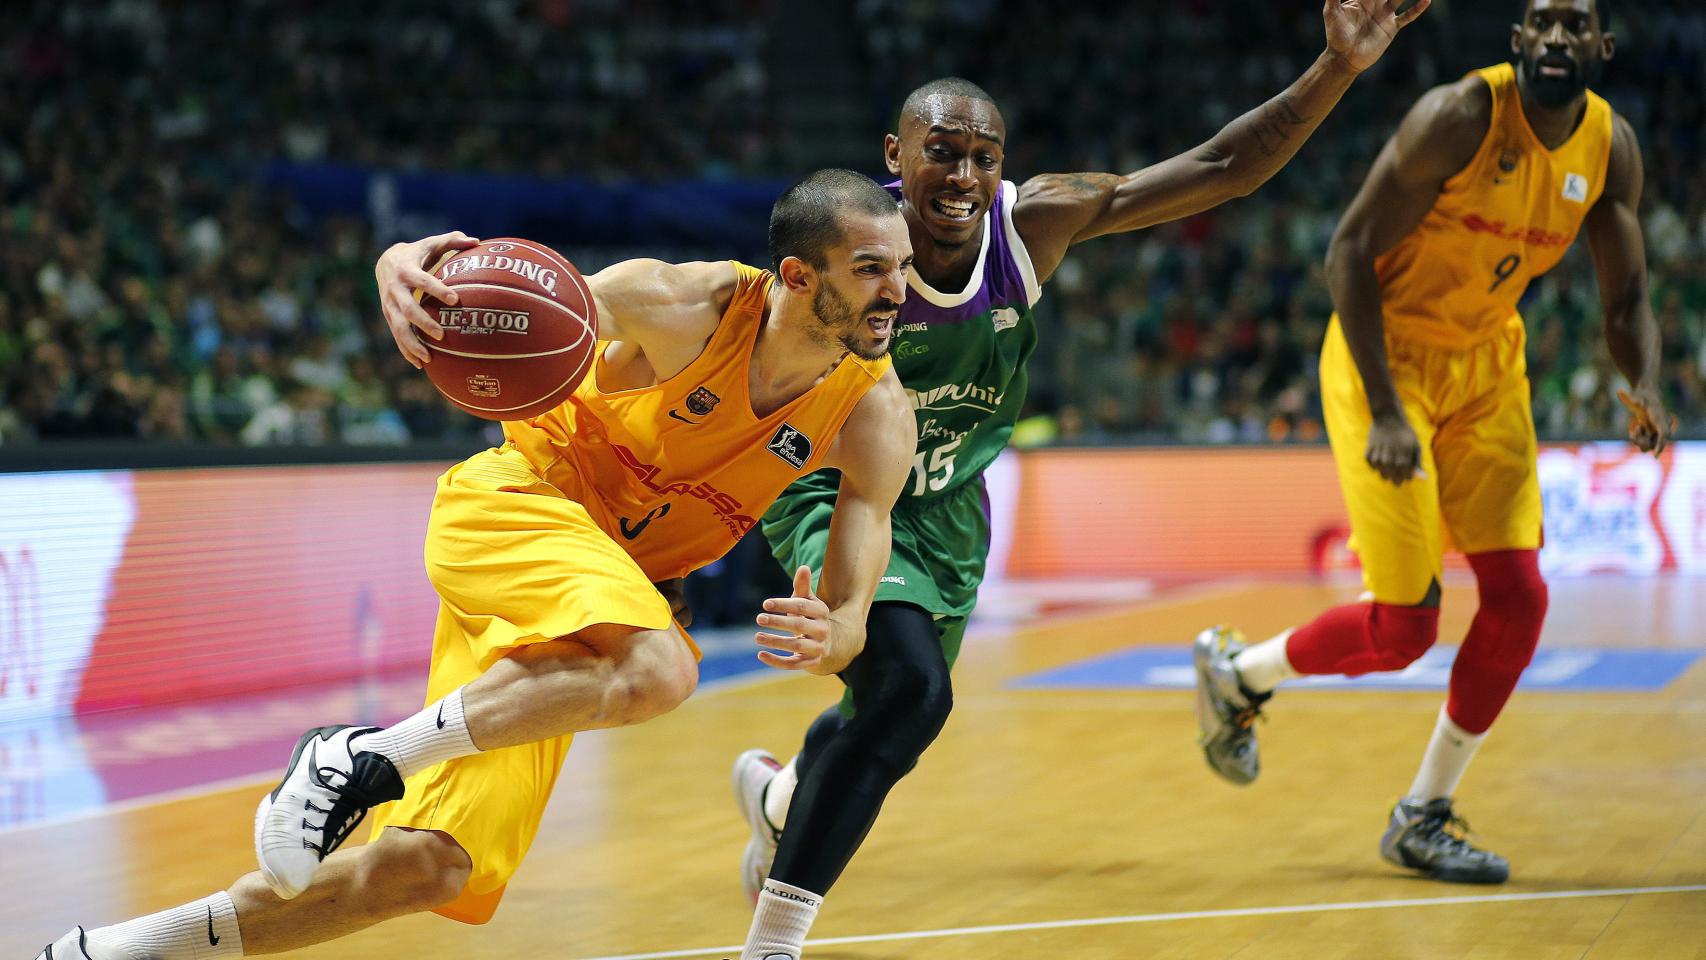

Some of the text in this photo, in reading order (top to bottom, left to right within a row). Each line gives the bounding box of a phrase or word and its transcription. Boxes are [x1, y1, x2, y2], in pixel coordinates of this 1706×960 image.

[441, 255, 557, 293] SPALDING
[1487, 253, 1520, 294] 9
[779, 447, 803, 466] endesa
[911, 437, 962, 497] 15
